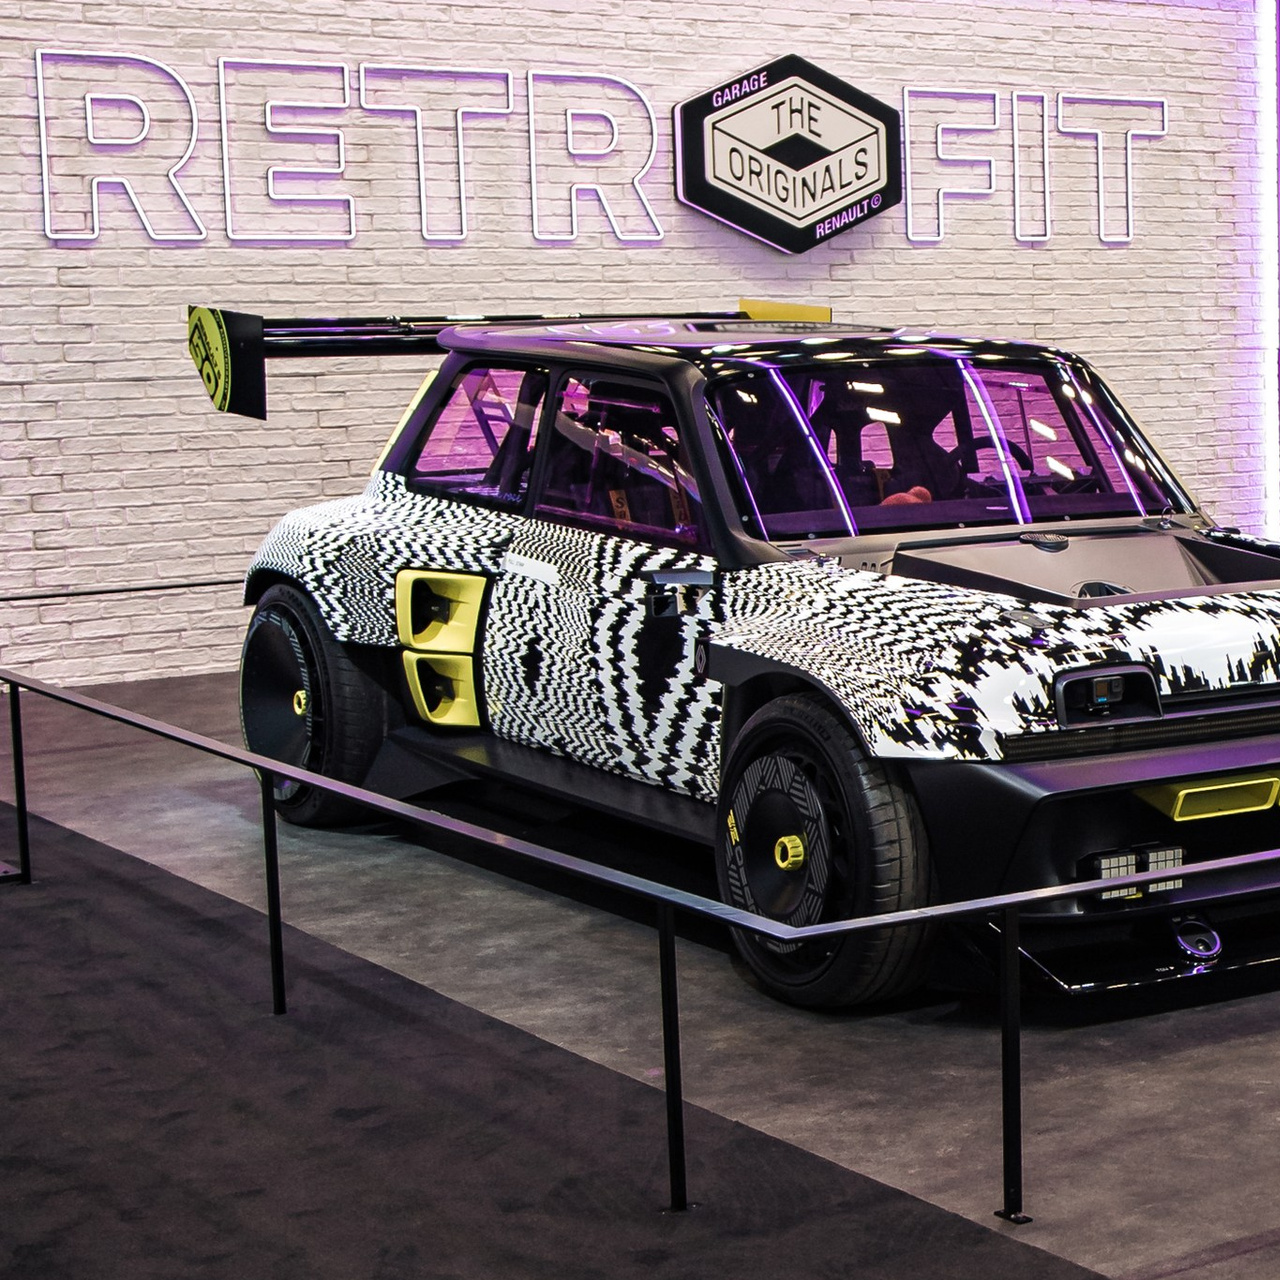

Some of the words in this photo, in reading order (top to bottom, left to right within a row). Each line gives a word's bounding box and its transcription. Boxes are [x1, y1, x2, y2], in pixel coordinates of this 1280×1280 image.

[712, 71, 769, 107] GARAGE
[771, 96, 822, 139] THE
[728, 147, 869, 209] ORIGINALS
[903, 86, 1169, 242] FIT
[815, 199, 869, 239] RENAULT
